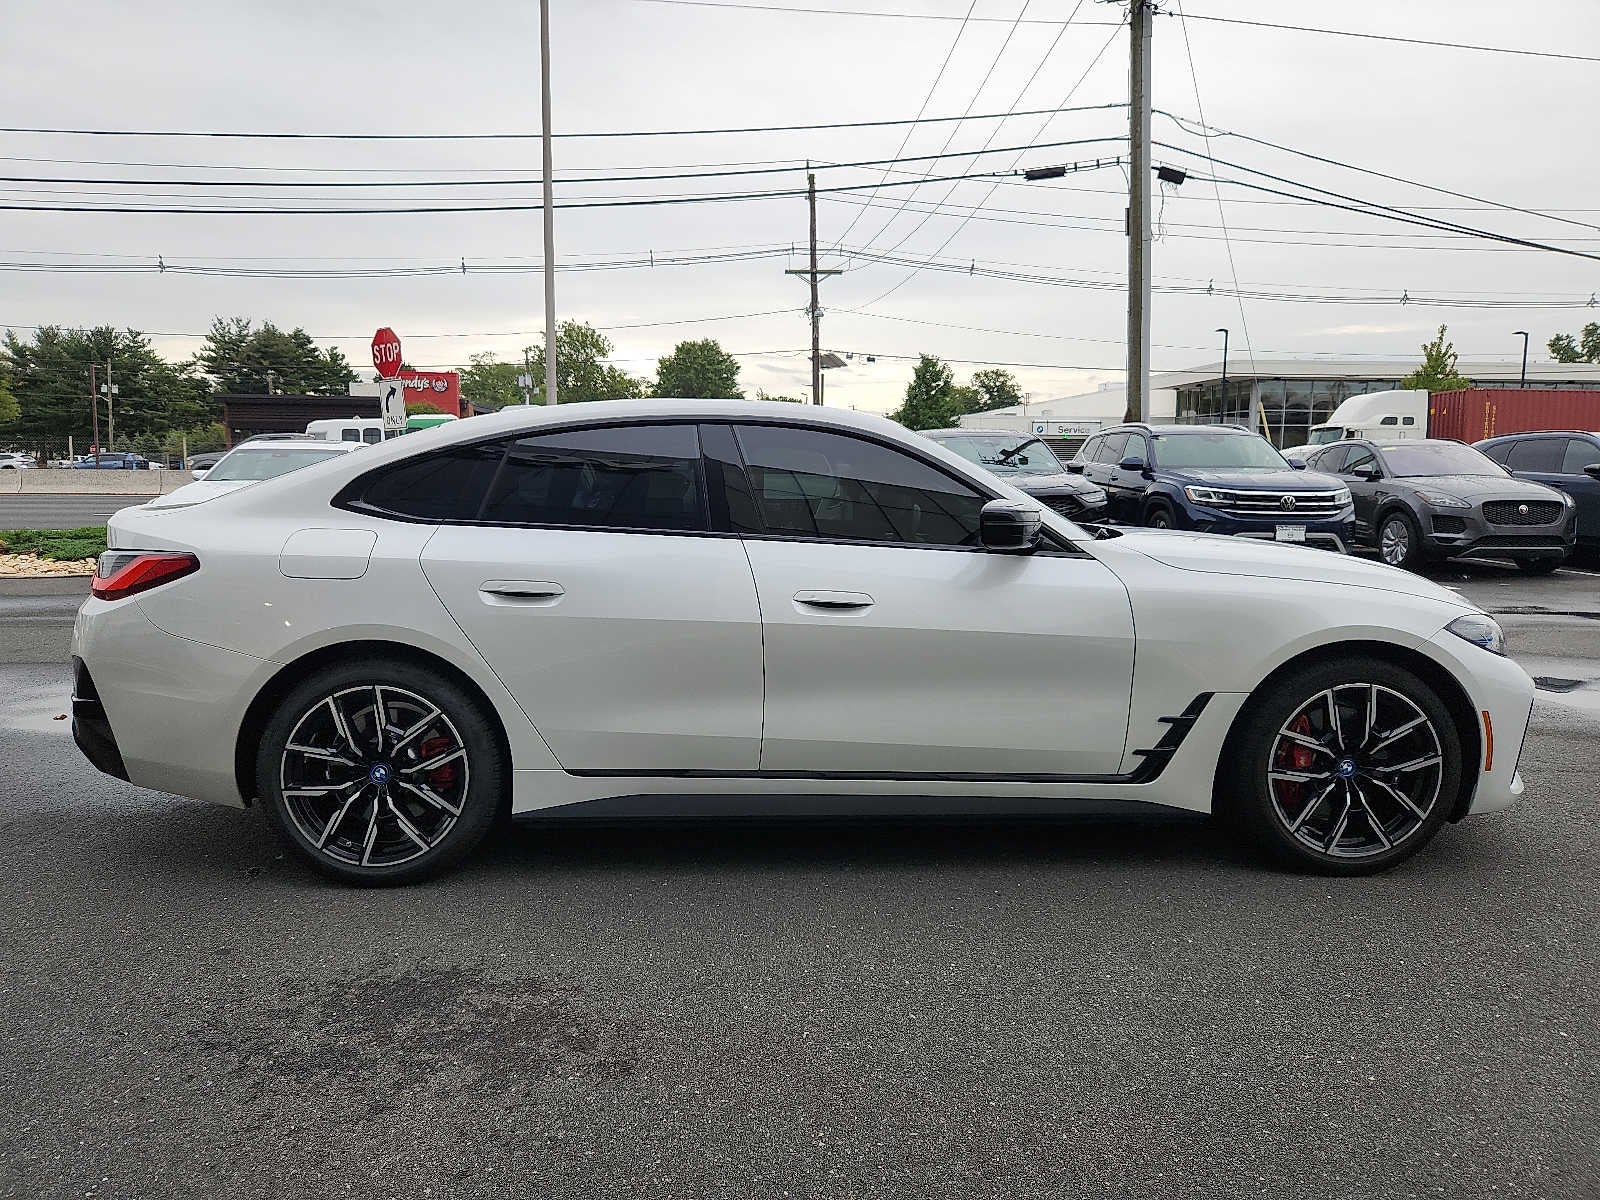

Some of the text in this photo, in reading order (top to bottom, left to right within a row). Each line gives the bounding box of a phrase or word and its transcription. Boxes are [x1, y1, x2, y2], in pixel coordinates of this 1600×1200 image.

[373, 342, 400, 364] STOP
[400, 374, 430, 392] ndy's
[386, 415, 403, 425] ONLY
[1057, 425, 1090, 434] Service
